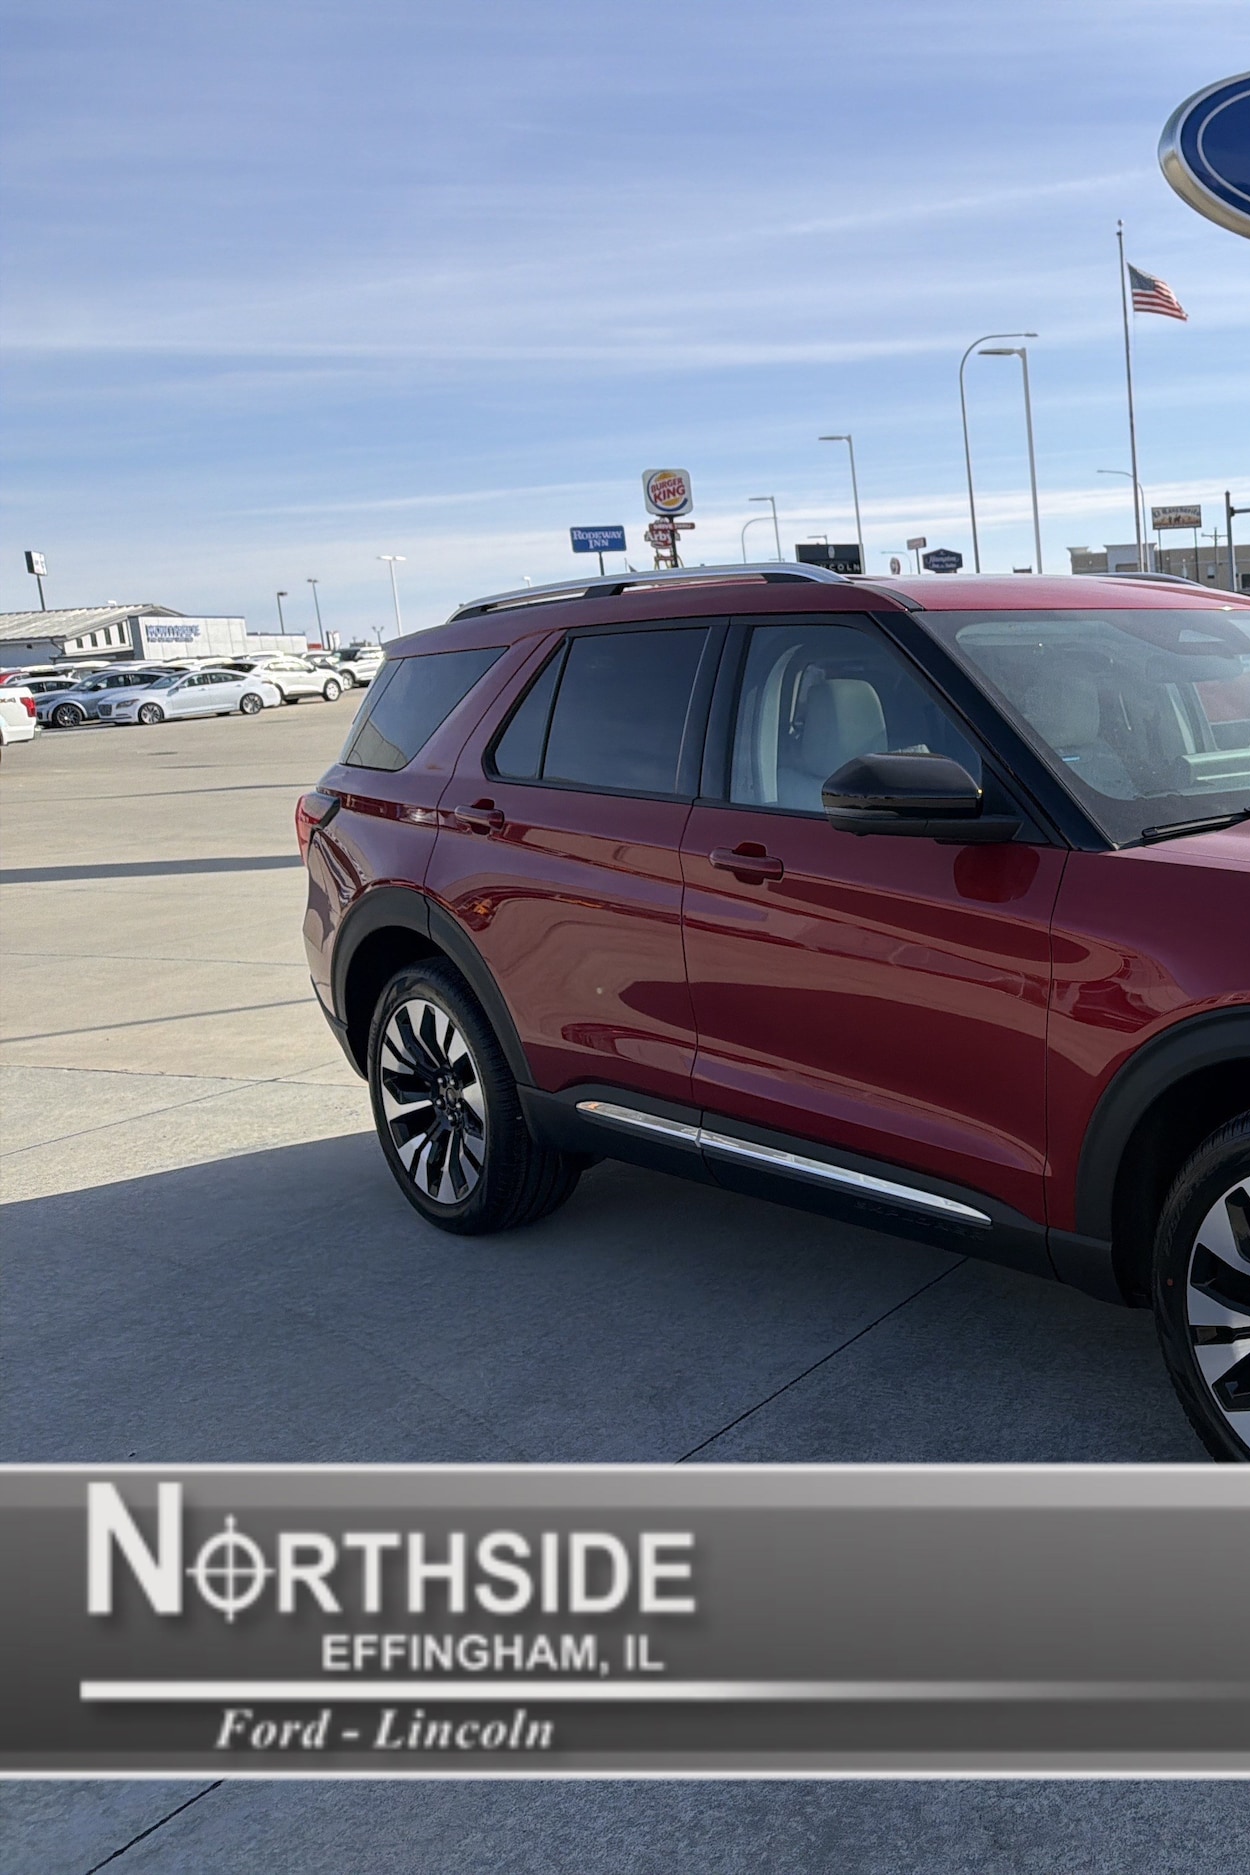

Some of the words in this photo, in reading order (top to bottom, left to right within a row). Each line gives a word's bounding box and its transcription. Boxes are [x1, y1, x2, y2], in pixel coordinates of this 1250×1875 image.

[651, 477, 683, 493] BURGER
[653, 485, 686, 503] KING
[573, 530, 622, 540] RODEWAY
[589, 539, 609, 549] INN
